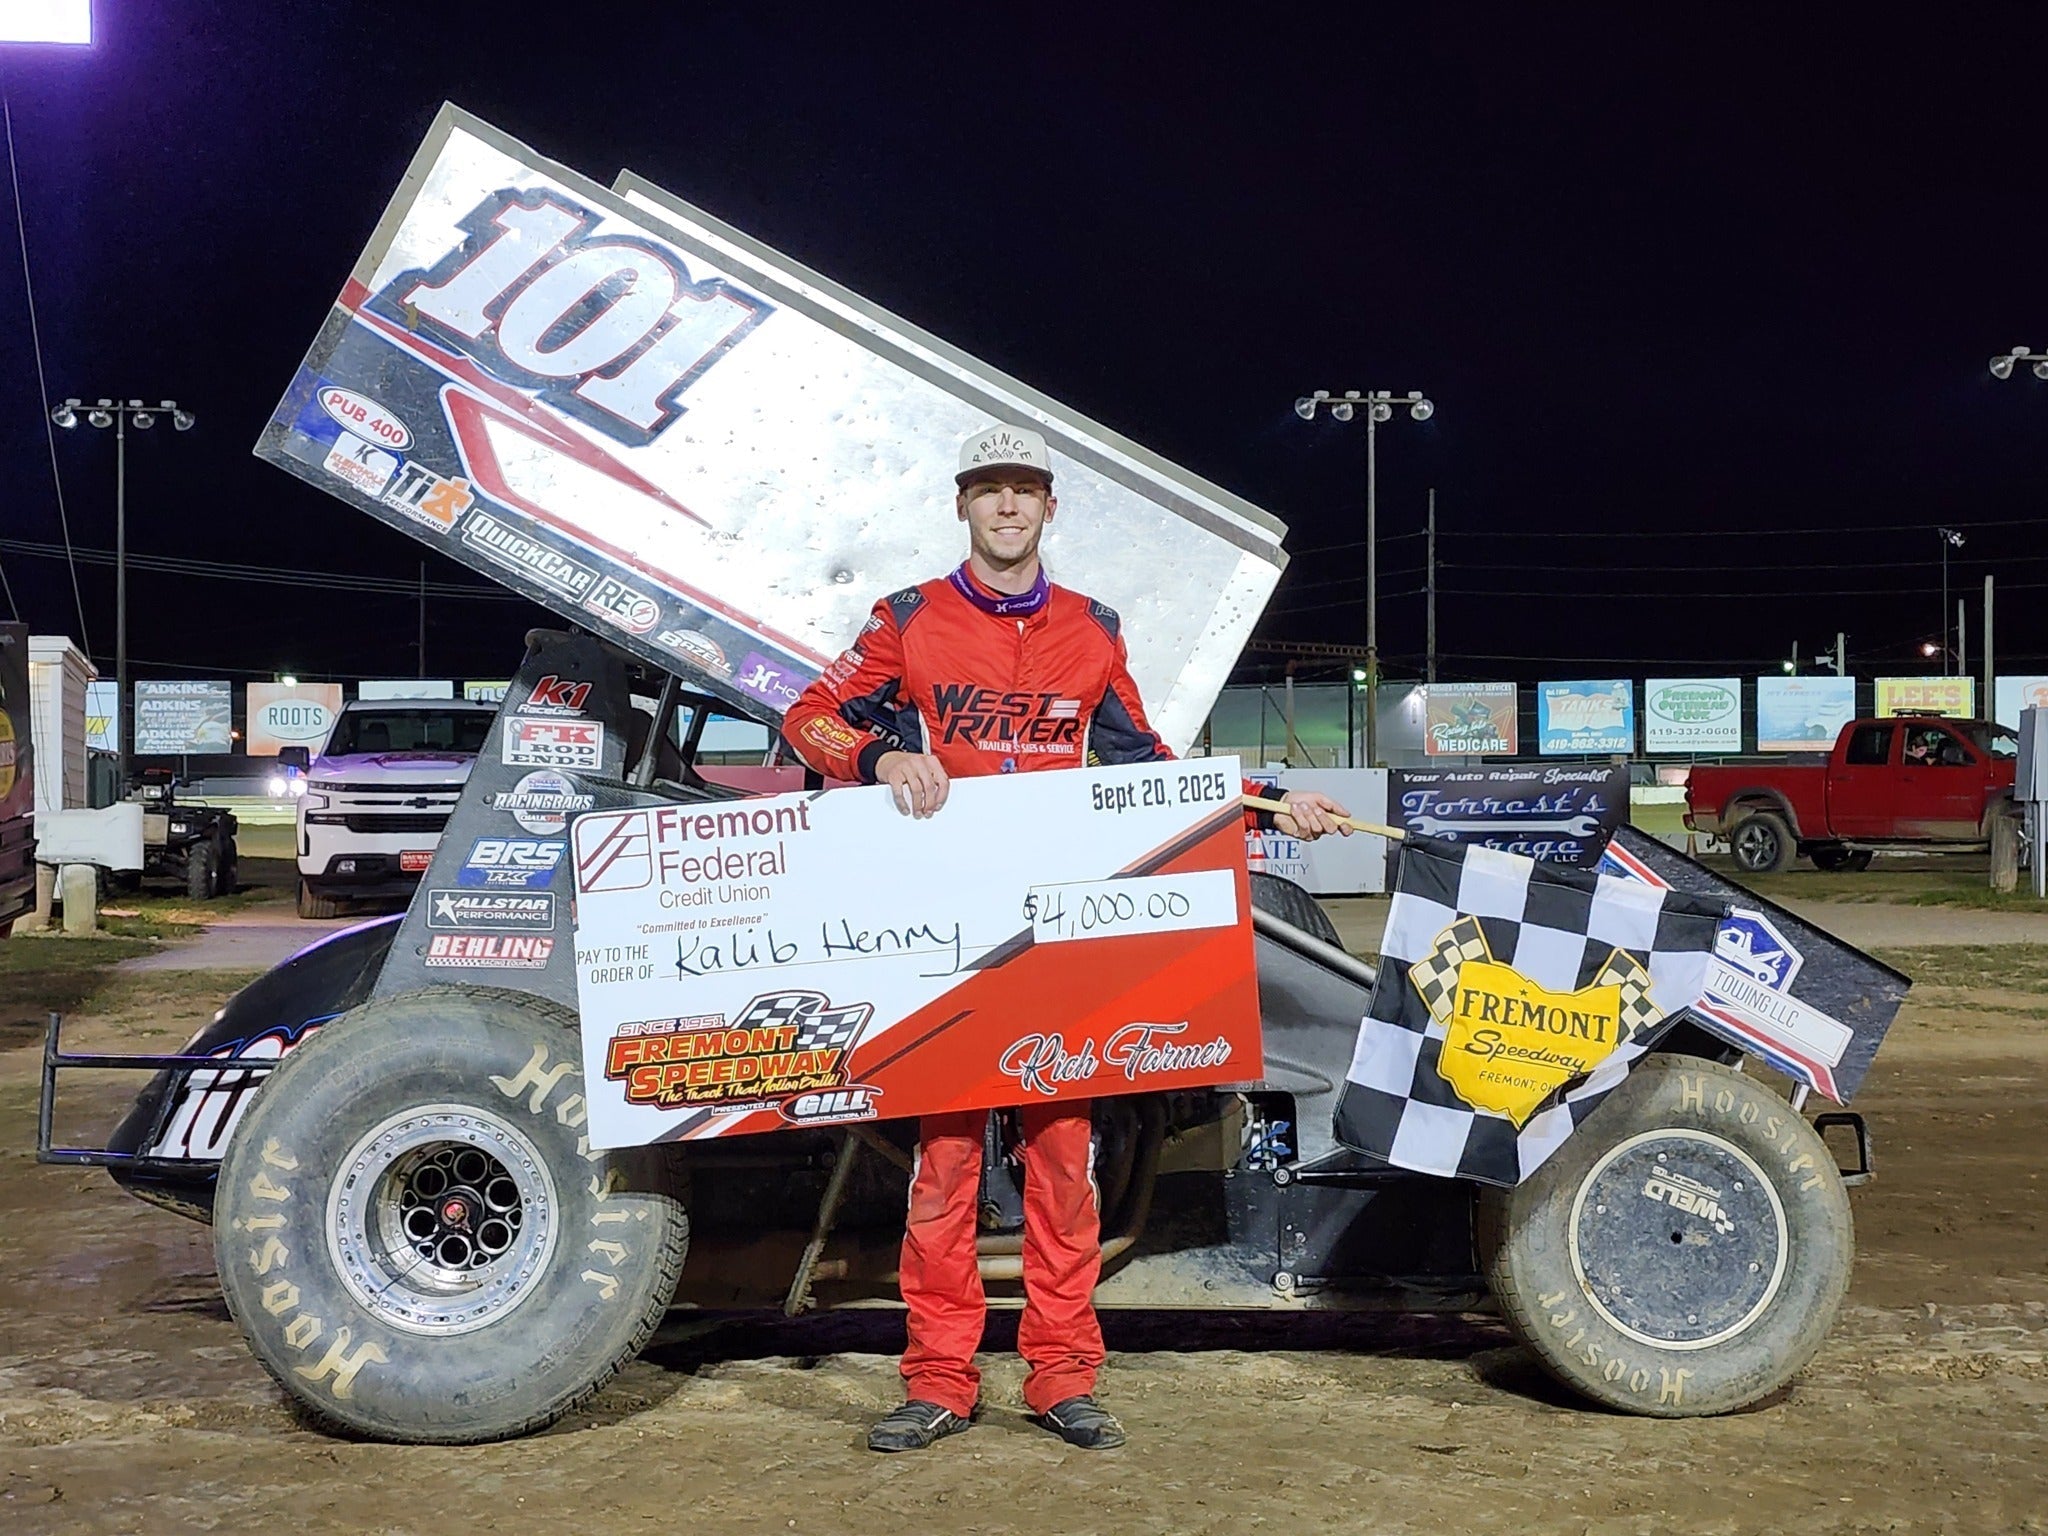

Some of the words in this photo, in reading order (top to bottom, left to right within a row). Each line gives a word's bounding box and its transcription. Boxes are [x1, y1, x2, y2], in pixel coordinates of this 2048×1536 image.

[385, 195, 768, 438] 101
[328, 393, 367, 422] PUB
[369, 418, 404, 443] 400
[973, 432, 1032, 462] PRINCE
[384, 496, 448, 533] PERFORMANCE
[146, 684, 208, 694] ADKINS
[528, 675, 592, 709] K1
[1887, 686, 1960, 706] LEE'S
[141, 700, 201, 711] ADKINS
[268, 707, 322, 725] ROOTS
[517, 704, 588, 716] RaceGear
[932, 684, 1063, 726] WEST
[138, 729, 195, 739] ADKINS
[520, 724, 595, 744] FK
[942, 714, 1081, 750] RIVER
[530, 744, 595, 755] ROD
[1046, 743, 1075, 753] SERVICE
[1437, 739, 1509, 751] MEDICARE
[511, 753, 595, 766] ENDS
[1402, 772, 1440, 783] Your
[1444, 772, 1484, 782] Auto
[1488, 771, 1540, 782] Repair
[1543, 768, 1613, 785] Specialist
[1092, 781, 1134, 814] Sept
[1141, 778, 1172, 808] 20,
[1177, 773, 1226, 804] 2025
[1402, 787, 1607, 816] Forrest's
[656, 800, 811, 843] Fremont
[469, 841, 567, 865] BRS
[658, 841, 786, 885] Federal
[1554, 854, 1578, 862] LLC
[454, 897, 549, 910] ALLSTAR
[660, 887, 714, 909] Credit
[718, 884, 771, 904] Union
[455, 911, 549, 921] PERFORMANCE
[698, 918, 708, 929] to
[1023, 891, 1190, 938] $4,000.00
[429, 935, 554, 959] BEHLING
[577, 949, 602, 966] PAY
[605, 947, 621, 962] TO
[625, 944, 649, 960] THE
[676, 929, 798, 981] Kalib
[591, 966, 636, 984] ORDER
[638, 964, 654, 979] OF
[1713, 969, 1771, 1014] TOWING
[1769, 998, 1799, 1030] LLC
[619, 1020, 677, 1036] SINCE
[679, 1016, 725, 1032] 1951
[1460, 988, 1611, 1043] FREMONT
[610, 1026, 800, 1074] FREMONT
[999, 1033, 1100, 1095] Rich
[1102, 1021, 1232, 1081] Farmer
[1460, 1030, 1587, 1079] Speedway
[630, 1049, 842, 1098] SPEEDWAY
[1478, 1070, 1536, 1091] FREMONT,
[657, 1089, 684, 1104] The
[686, 1086, 726, 1100] Track
[727, 1081, 759, 1098] That
[793, 1090, 868, 1115] GILL
[714, 1103, 765, 1114] PRESENTED
[766, 1101, 780, 1109] BY:
[859, 1110, 876, 1118] LLC
[1644, 1179, 1719, 1222] WELD
